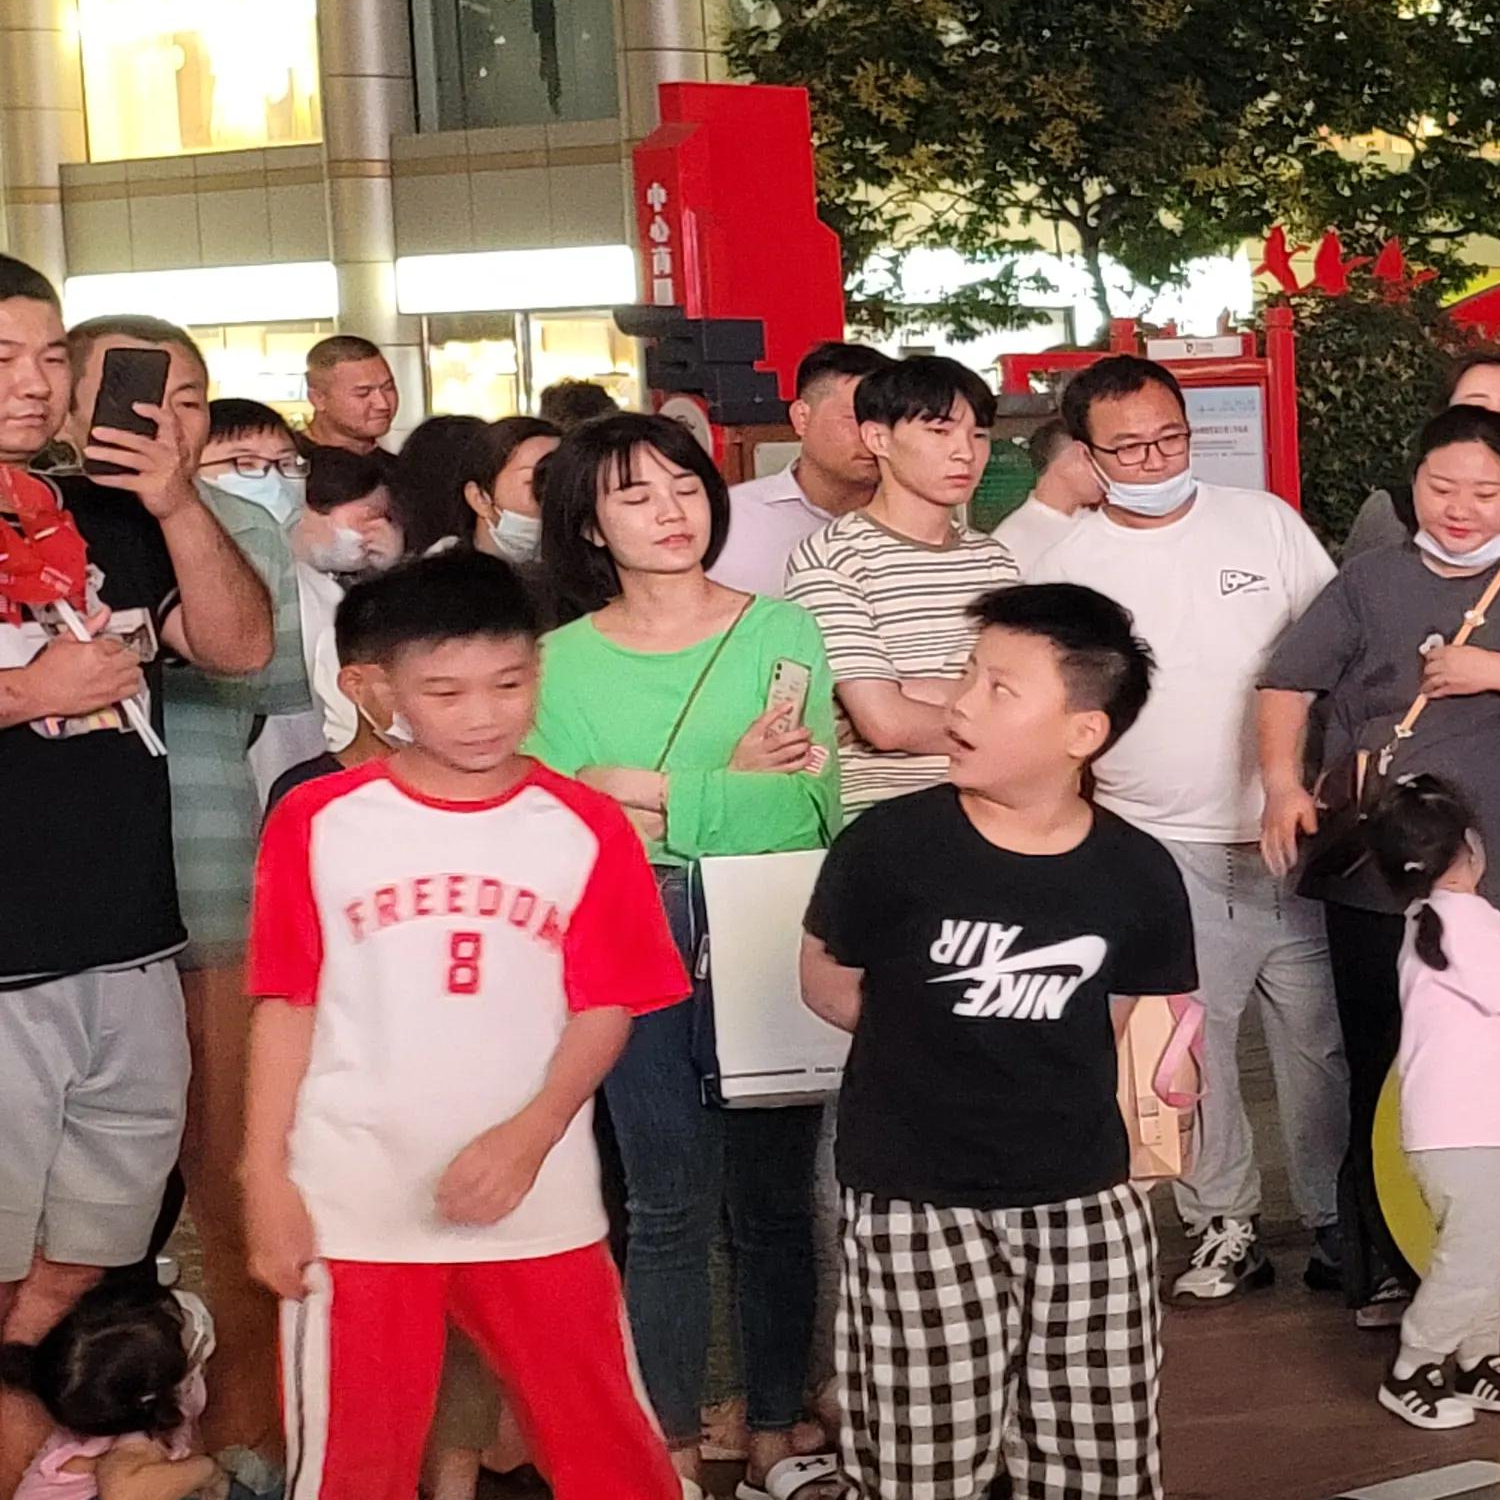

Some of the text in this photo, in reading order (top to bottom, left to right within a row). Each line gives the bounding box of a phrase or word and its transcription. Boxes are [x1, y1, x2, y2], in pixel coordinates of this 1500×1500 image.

[448, 932, 482, 994] 8
[930, 919, 1025, 970] AIR
[952, 973, 1082, 1021] NIKE
